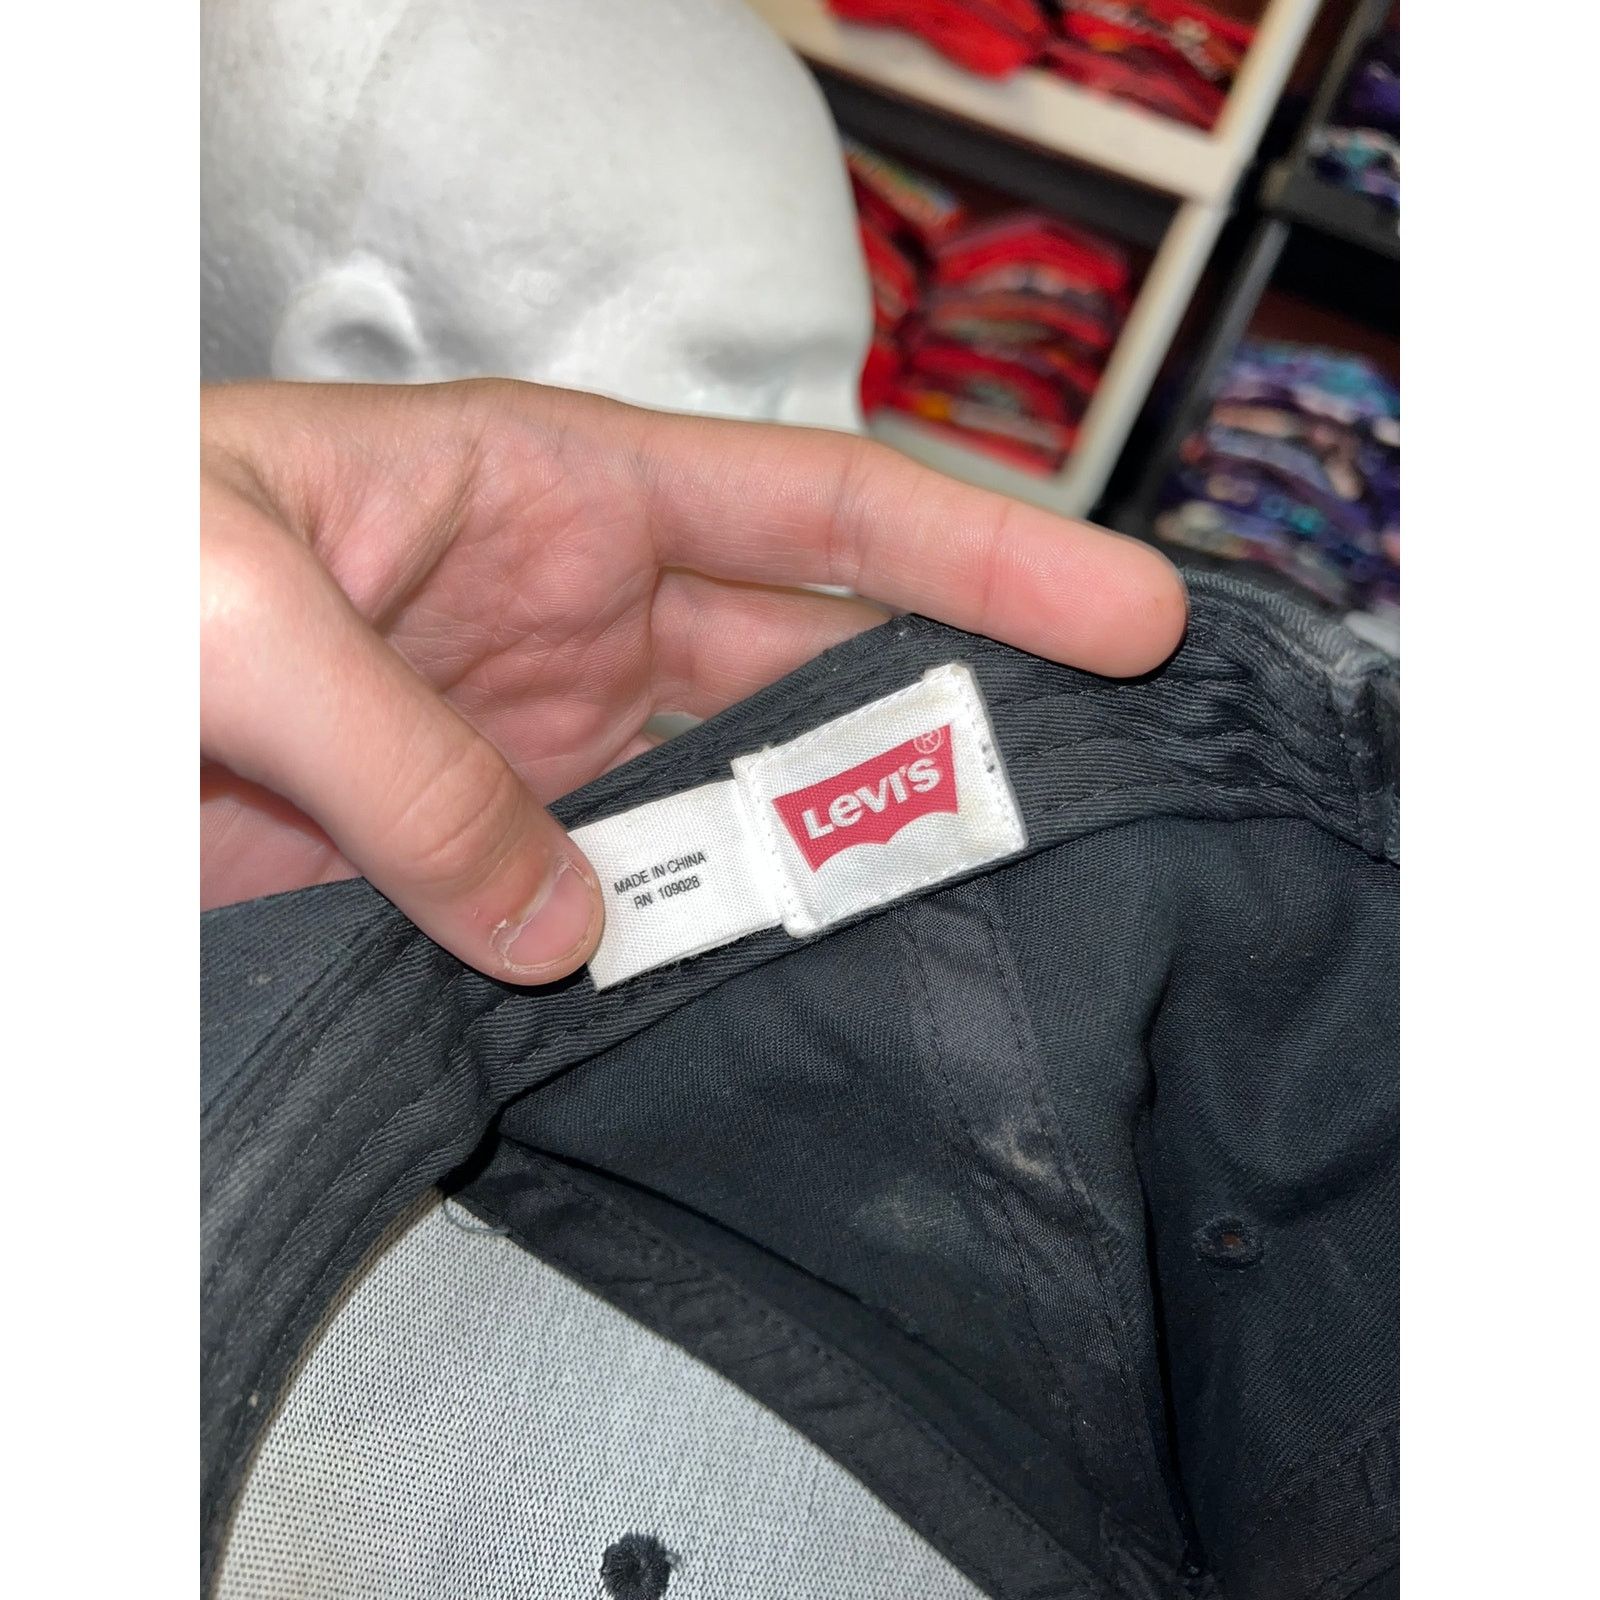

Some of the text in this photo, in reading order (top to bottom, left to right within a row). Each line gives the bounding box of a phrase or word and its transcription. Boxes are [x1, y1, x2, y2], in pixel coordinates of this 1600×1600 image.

[613, 851, 707, 895] MADE IN CHINA
[633, 875, 700, 910] RN 109028
